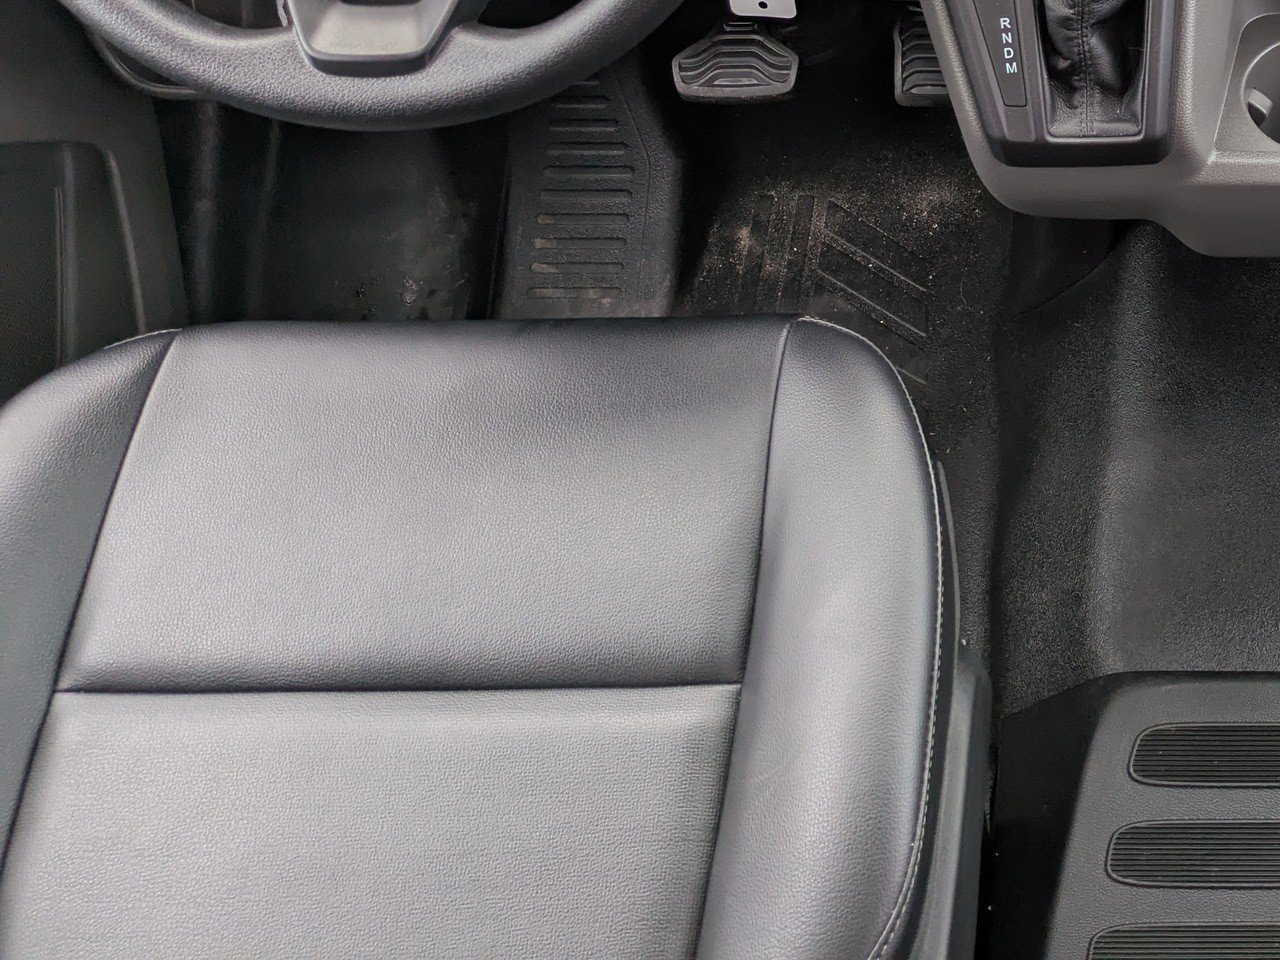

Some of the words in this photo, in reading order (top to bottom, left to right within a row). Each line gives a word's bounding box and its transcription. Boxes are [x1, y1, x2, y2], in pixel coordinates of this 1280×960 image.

[1000, 17, 1012, 29] R
[1002, 32, 1012, 44] N
[1004, 47, 1014, 59] D
[1005, 62, 1018, 74] M
